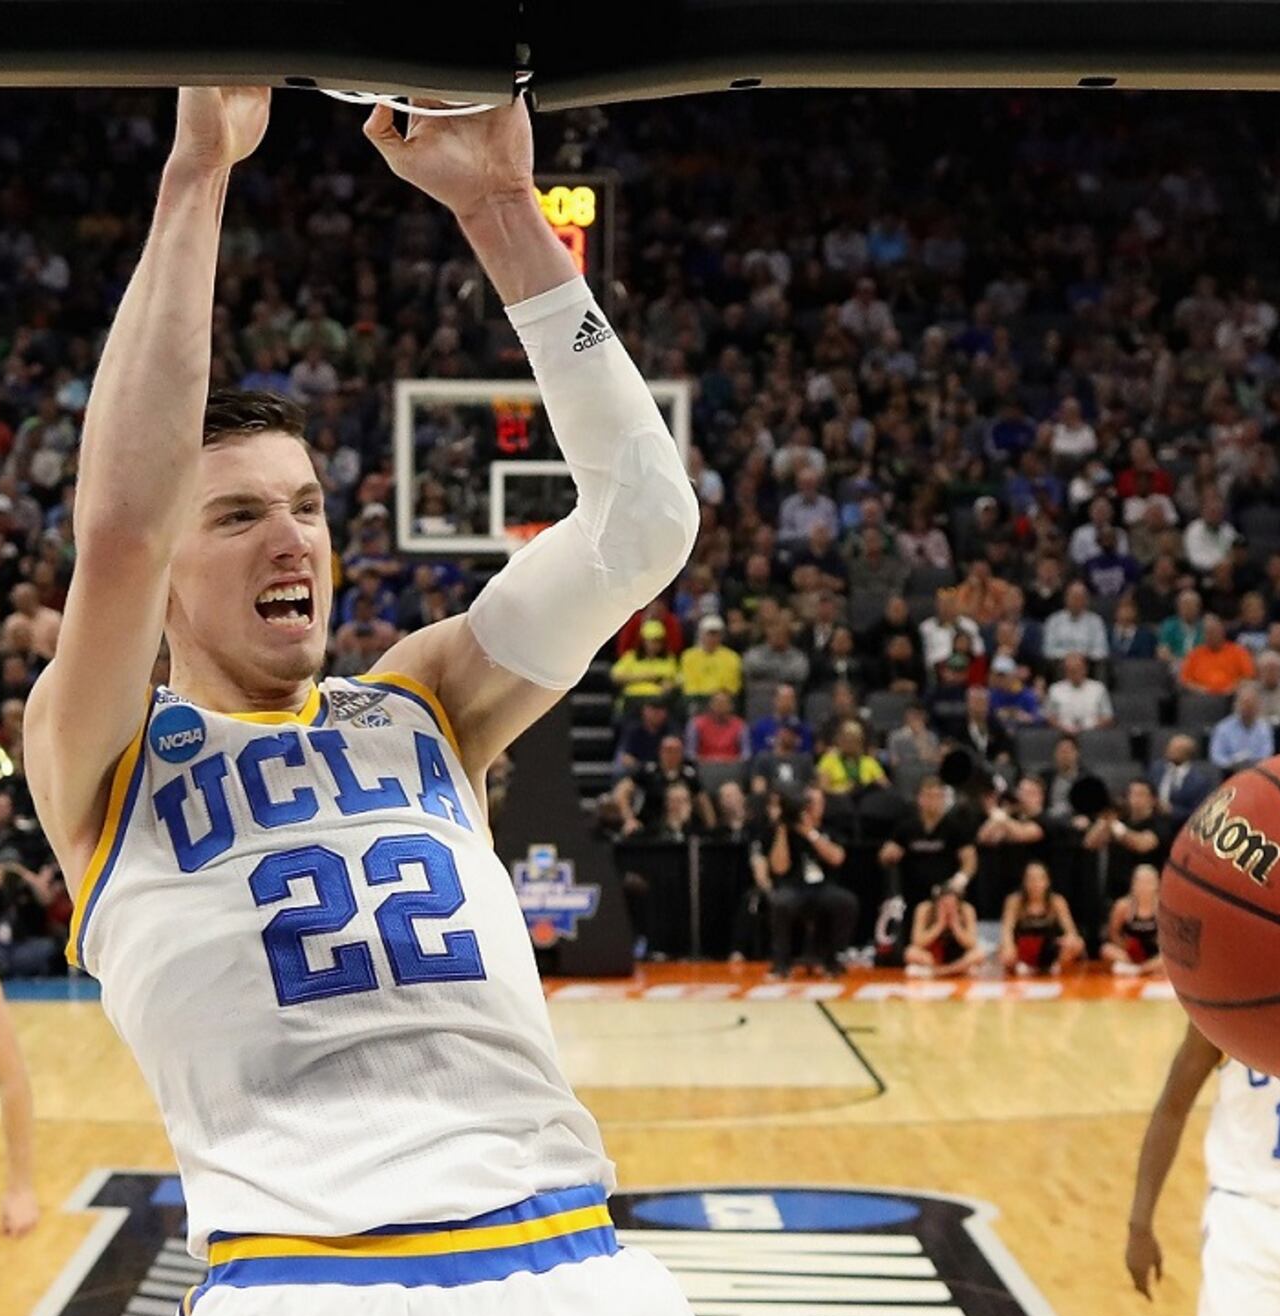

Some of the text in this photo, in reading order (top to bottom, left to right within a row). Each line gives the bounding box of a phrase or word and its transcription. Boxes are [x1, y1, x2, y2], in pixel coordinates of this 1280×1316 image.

[153, 731, 474, 873] UCLA
[158, 727, 204, 751] NCAA
[248, 834, 487, 1007] 22
